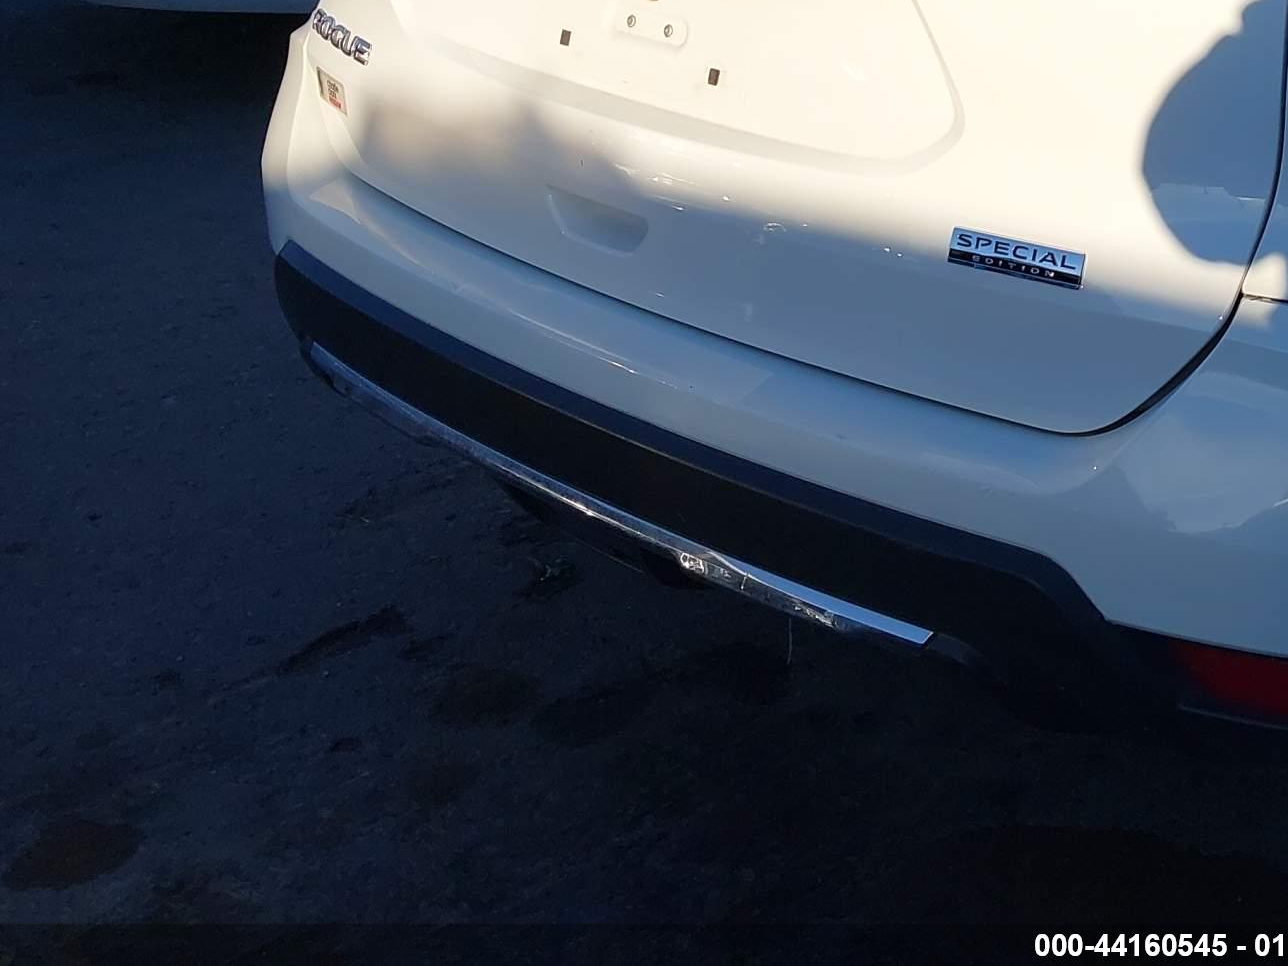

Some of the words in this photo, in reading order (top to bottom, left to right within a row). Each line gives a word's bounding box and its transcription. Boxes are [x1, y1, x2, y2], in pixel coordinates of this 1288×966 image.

[312, 8, 372, 66] ROGUE
[956, 233, 1076, 269] SPECIAL
[972, 254, 1055, 278] EDITION
